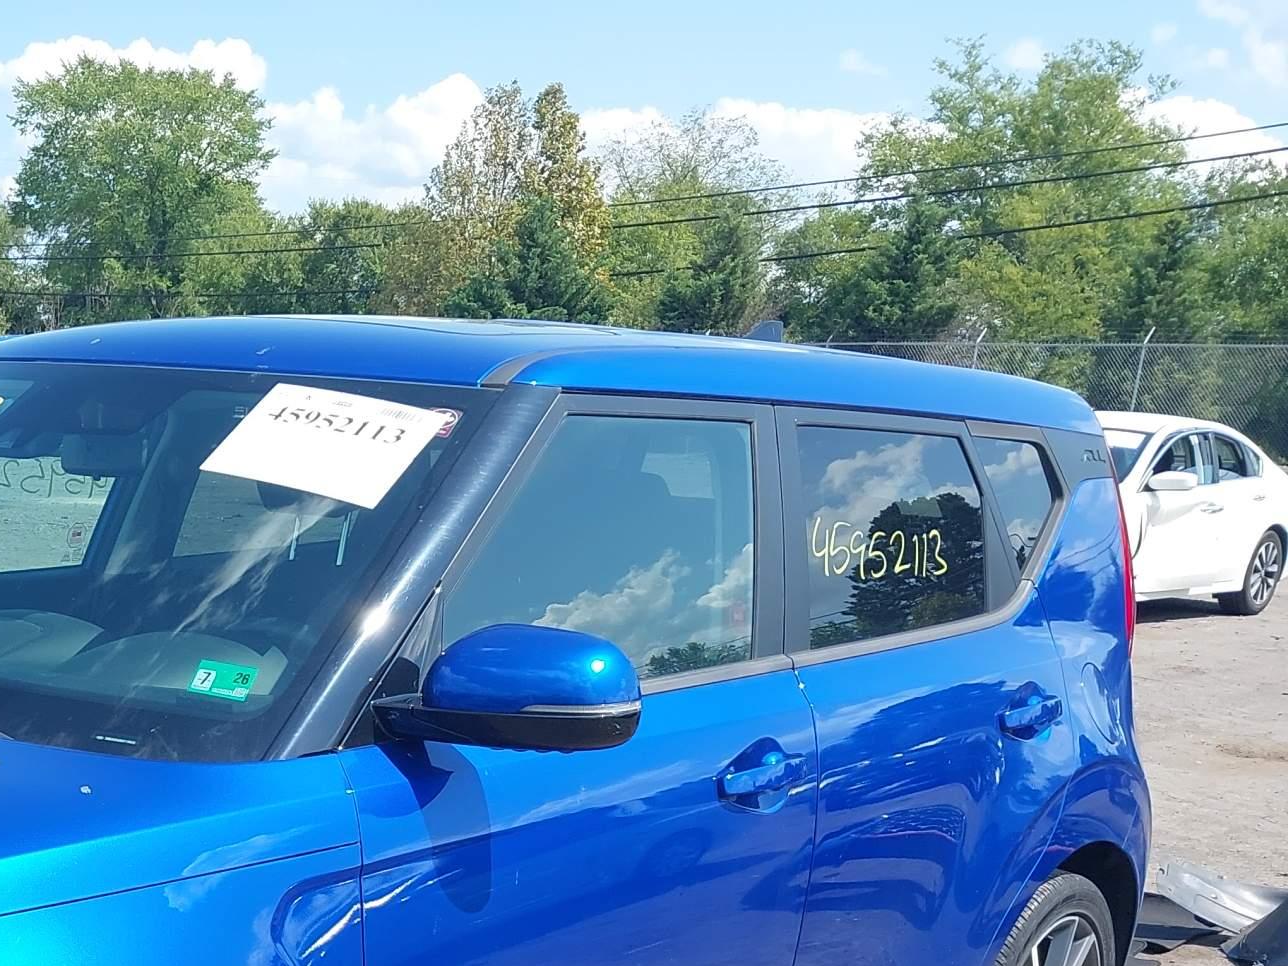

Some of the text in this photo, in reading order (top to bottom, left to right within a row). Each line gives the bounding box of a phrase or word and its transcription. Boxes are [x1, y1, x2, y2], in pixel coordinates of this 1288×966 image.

[267, 406, 407, 444] 45952113
[812, 516, 949, 580] 45952113
[199, 671, 251, 686] 7 26
